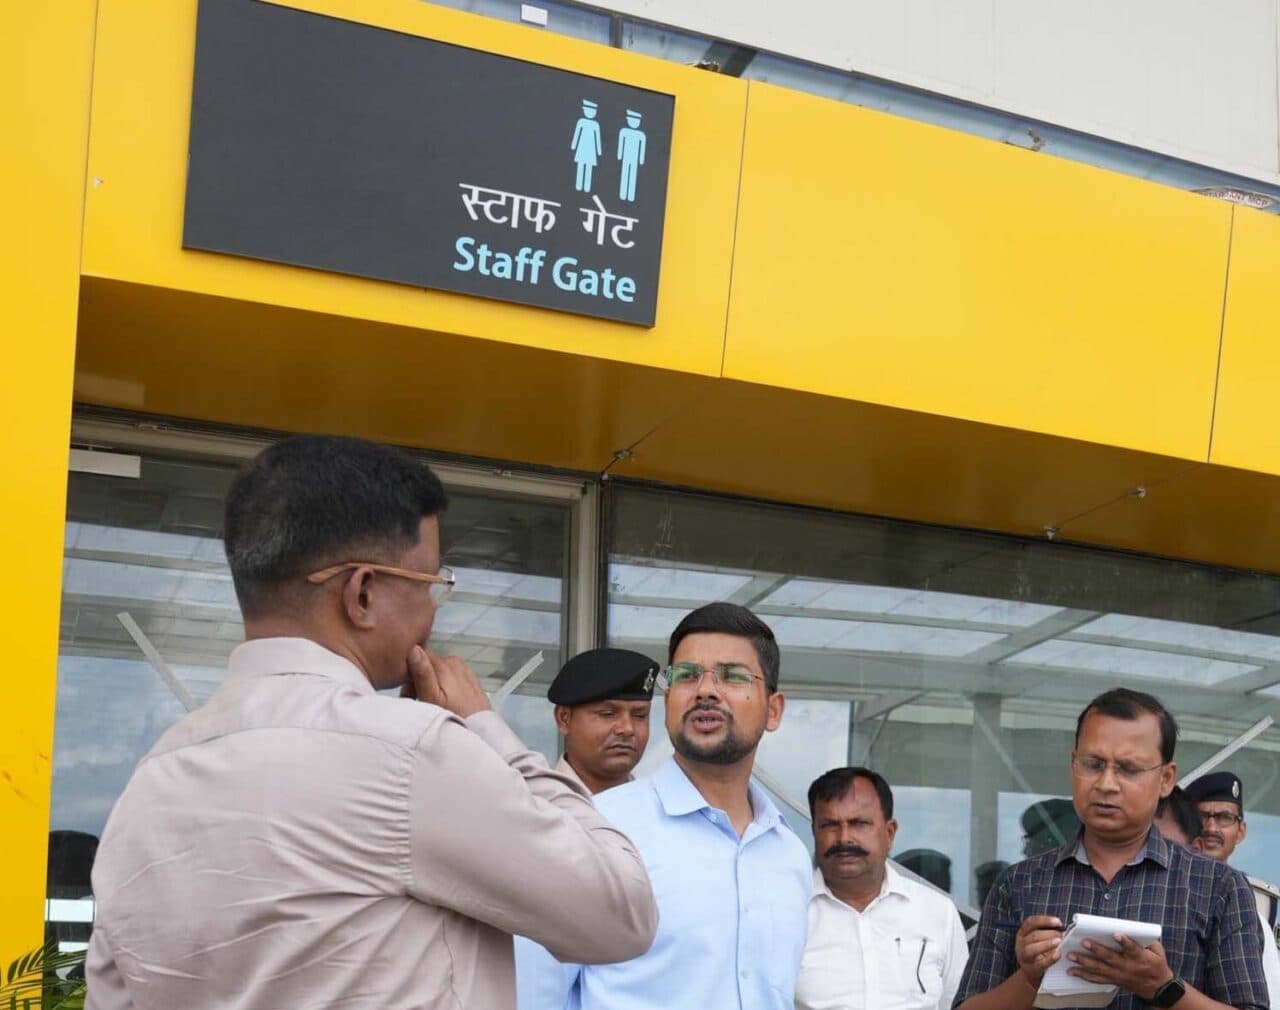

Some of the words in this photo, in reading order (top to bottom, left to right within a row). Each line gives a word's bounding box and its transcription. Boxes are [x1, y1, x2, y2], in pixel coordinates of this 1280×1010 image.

[459, 183, 561, 233] स्टाफ
[580, 195, 638, 248] गेट
[454, 237, 546, 284] Staff
[553, 257, 636, 302] Gate
